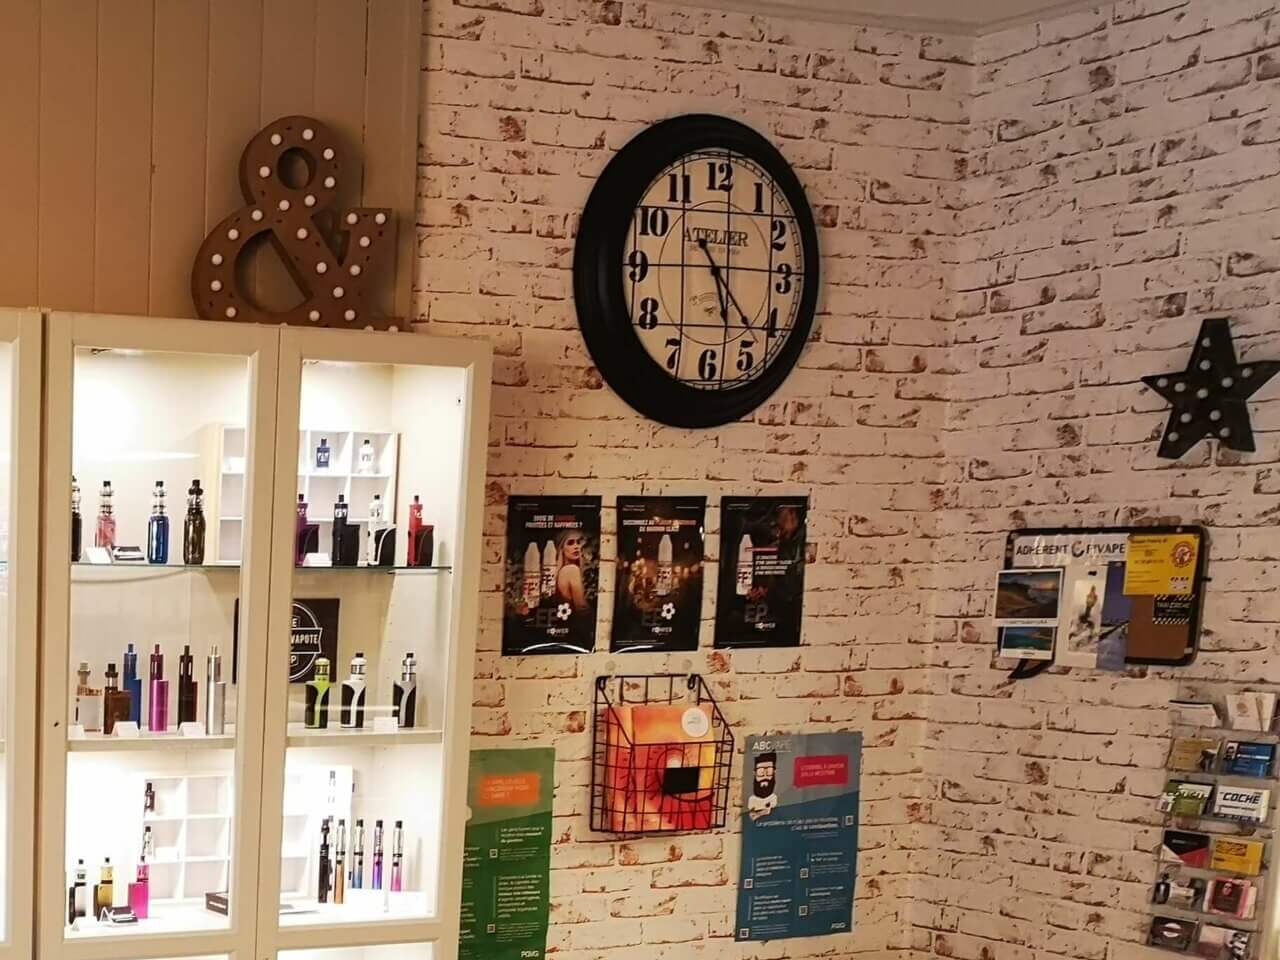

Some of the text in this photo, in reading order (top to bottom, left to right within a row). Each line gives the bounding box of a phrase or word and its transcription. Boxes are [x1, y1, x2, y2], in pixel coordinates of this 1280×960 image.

[668, 173, 692, 203] 11
[707, 162, 733, 193] 12
[753, 183, 764, 213] 1
[639, 206, 669, 237] 10
[772, 219, 786, 251] 2
[683, 227, 749, 248] ATELIER
[628, 250, 648, 283] 9
[775, 263, 792, 294] 3
[639, 297, 659, 330] 8
[763, 308, 779, 338] 4
[665, 338, 681, 370] 7
[698, 349, 717, 381] 6
[736, 339, 755, 372] 5
[1222, 792, 1261, 804] COCHE
